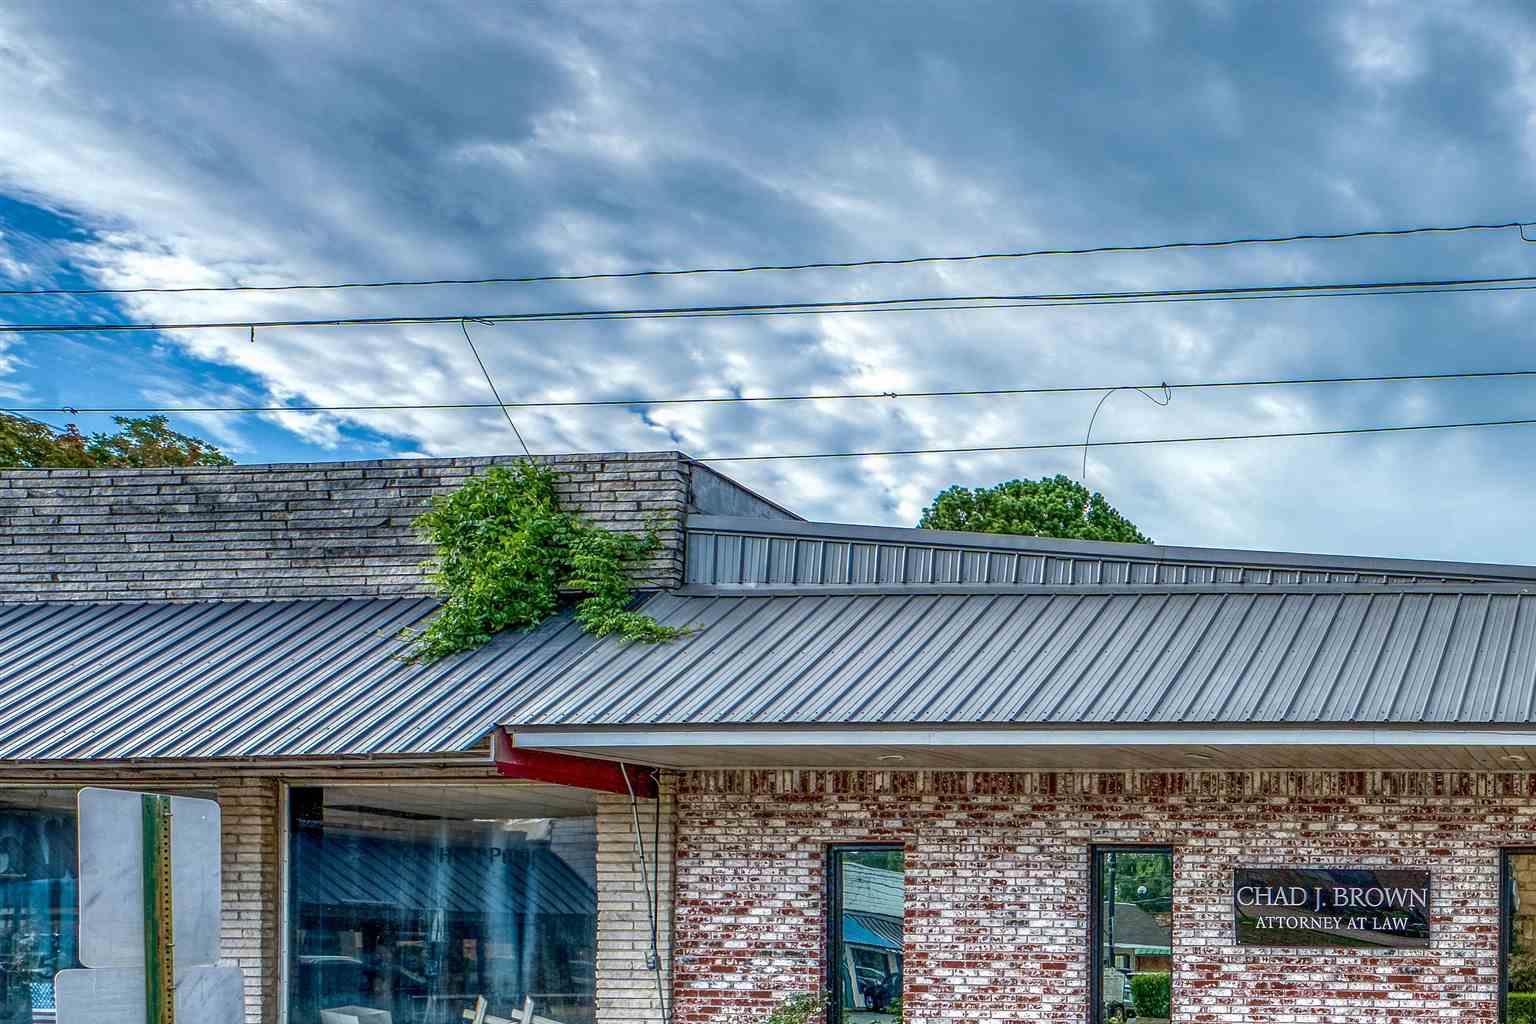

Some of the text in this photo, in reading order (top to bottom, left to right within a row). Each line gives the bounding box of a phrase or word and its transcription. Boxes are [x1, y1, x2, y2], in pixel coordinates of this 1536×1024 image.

[1236, 886, 1427, 912] CHAD J. BROWN
[1256, 915, 1408, 931] ATTORNEY AT LAW
